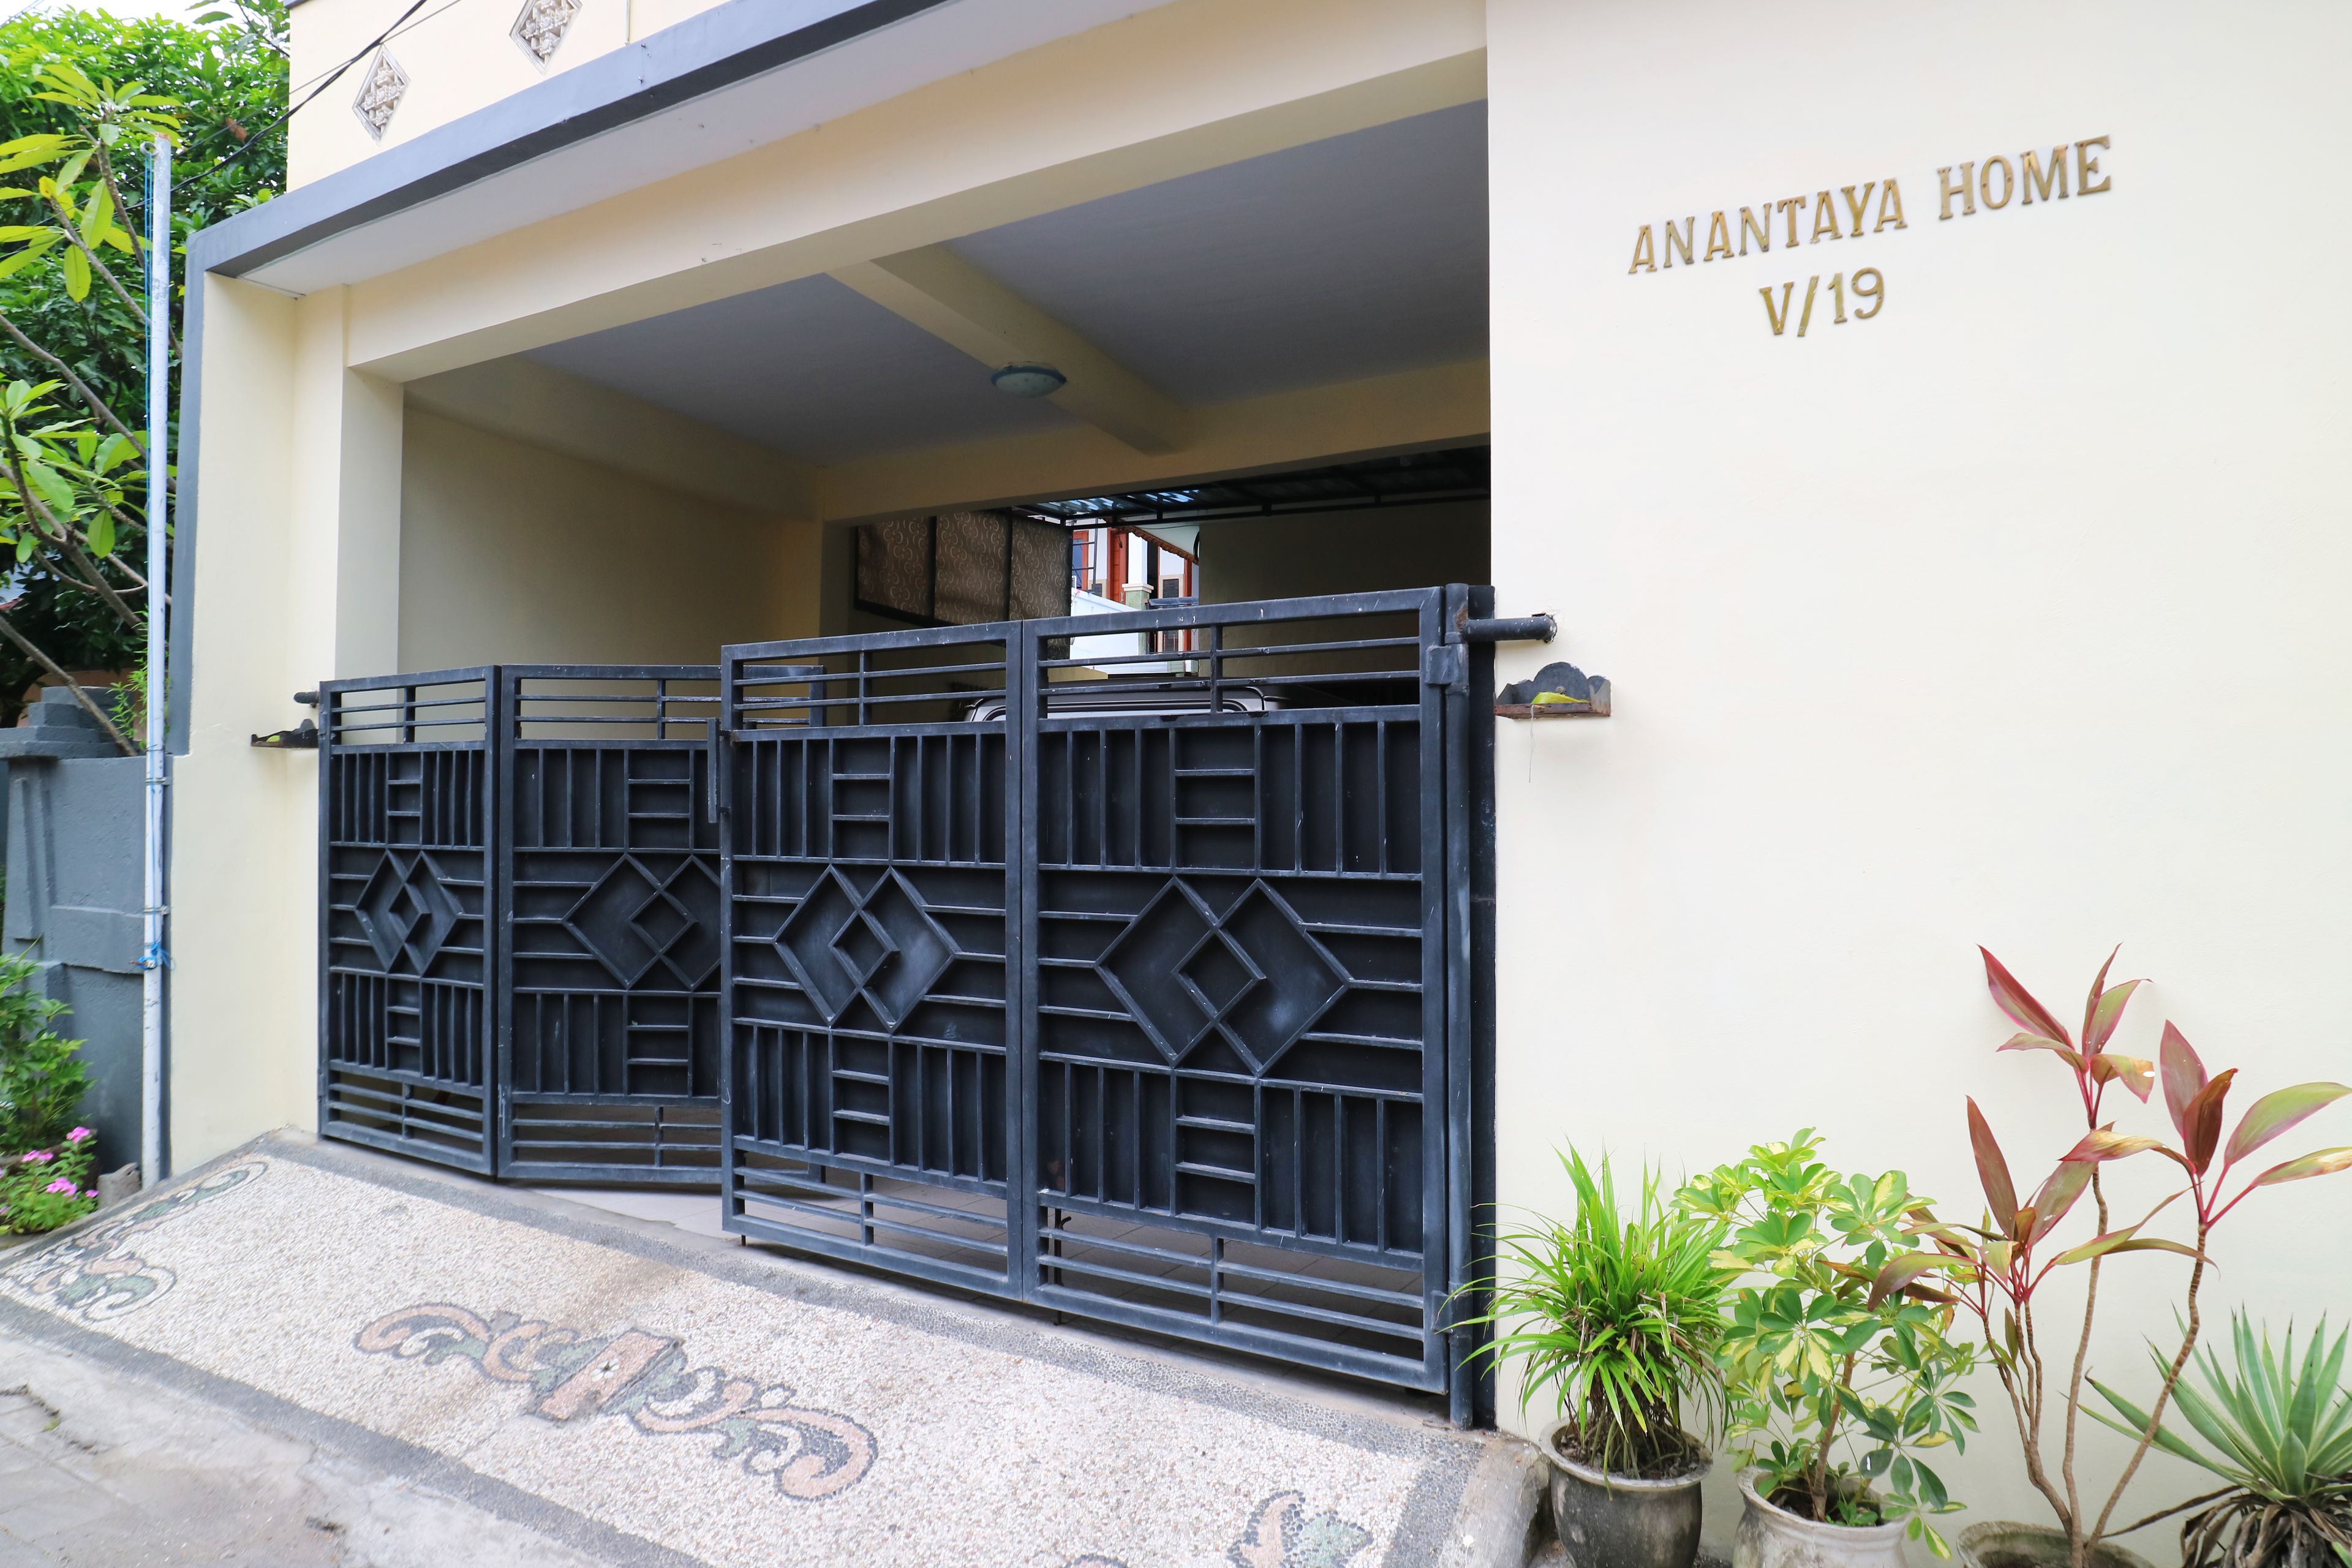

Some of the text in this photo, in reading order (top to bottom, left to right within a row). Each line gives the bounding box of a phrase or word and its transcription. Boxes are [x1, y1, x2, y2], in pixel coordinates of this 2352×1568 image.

[1628, 135, 2111, 274] ANANTAYA HOME
[1760, 268, 1885, 337] V/19
